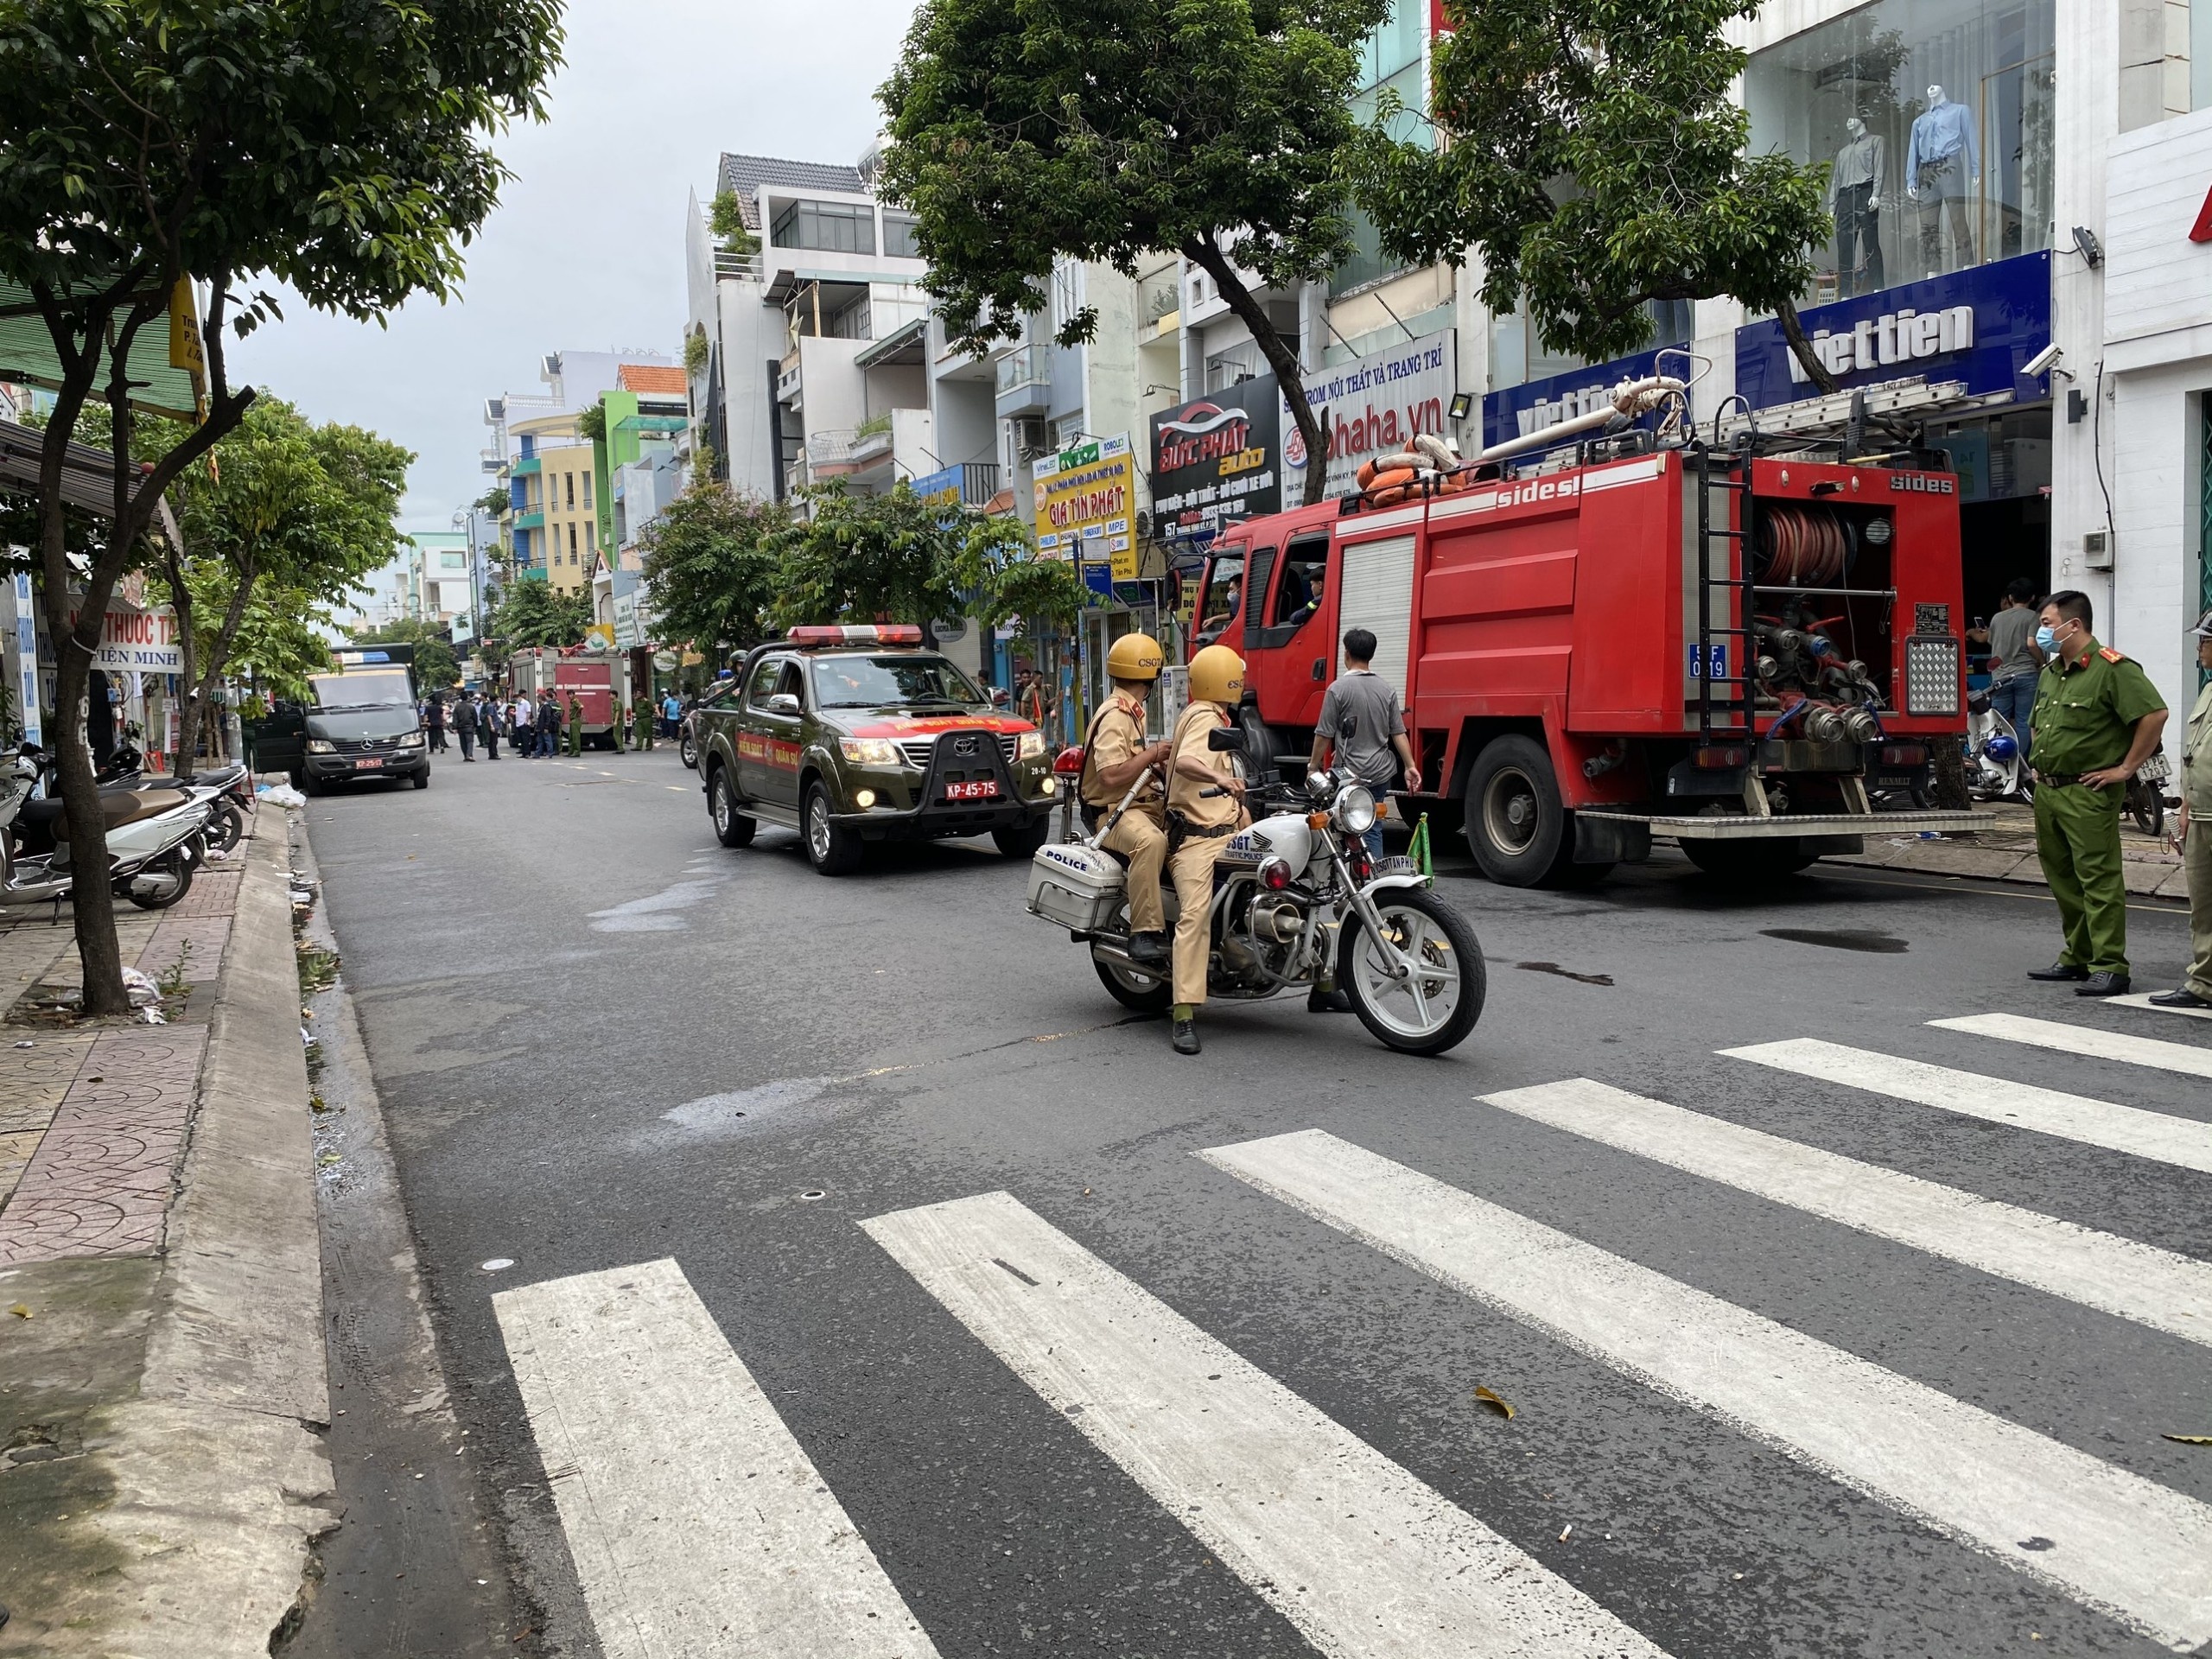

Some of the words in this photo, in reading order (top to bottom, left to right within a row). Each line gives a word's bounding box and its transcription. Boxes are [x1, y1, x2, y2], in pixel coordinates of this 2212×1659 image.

[1328, 376, 1344, 402] NỘI
[1346, 364, 1371, 393] THẤT
[1373, 362, 1384, 385] VÀ
[1387, 354, 1421, 382] TRANG
[1423, 342, 1442, 370] TRÍ
[1219, 448, 1265, 475] auto
[1891, 474, 1954, 493] sides
[1050, 500, 1071, 526] GIA
[1071, 489, 1089, 522] TÍN
[1090, 480, 1126, 518] PHÁT
[1108, 520, 1125, 532] MPE
[1164, 521, 1176, 537] 157
[1040, 535, 1056, 546] PHILIPS
[135, 652, 178, 665] MINH
[1138, 658, 1160, 667] CSGT
[1031, 766, 1046, 775] 20-10
[1878, 777, 1911, 785] RENAULT
[947, 783, 995, 798] KP-45-75
[1046, 850, 1088, 872] POLICE
